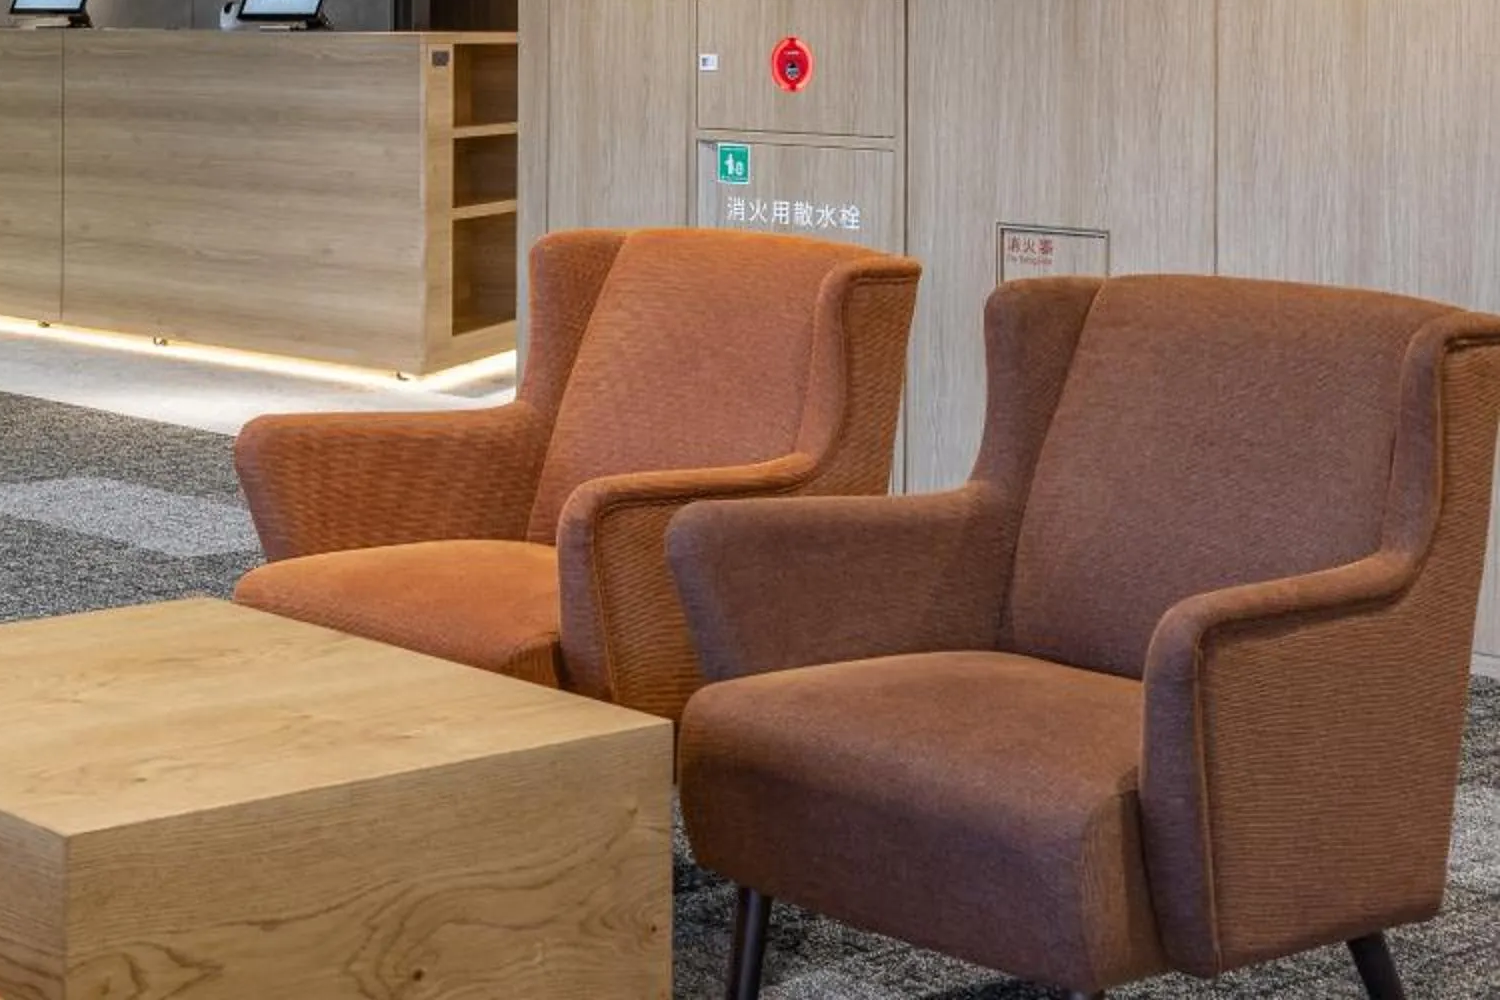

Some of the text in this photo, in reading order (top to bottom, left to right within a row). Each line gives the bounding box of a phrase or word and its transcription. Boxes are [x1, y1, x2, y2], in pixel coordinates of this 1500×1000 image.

[726, 196, 861, 230] 消火用散水栓
